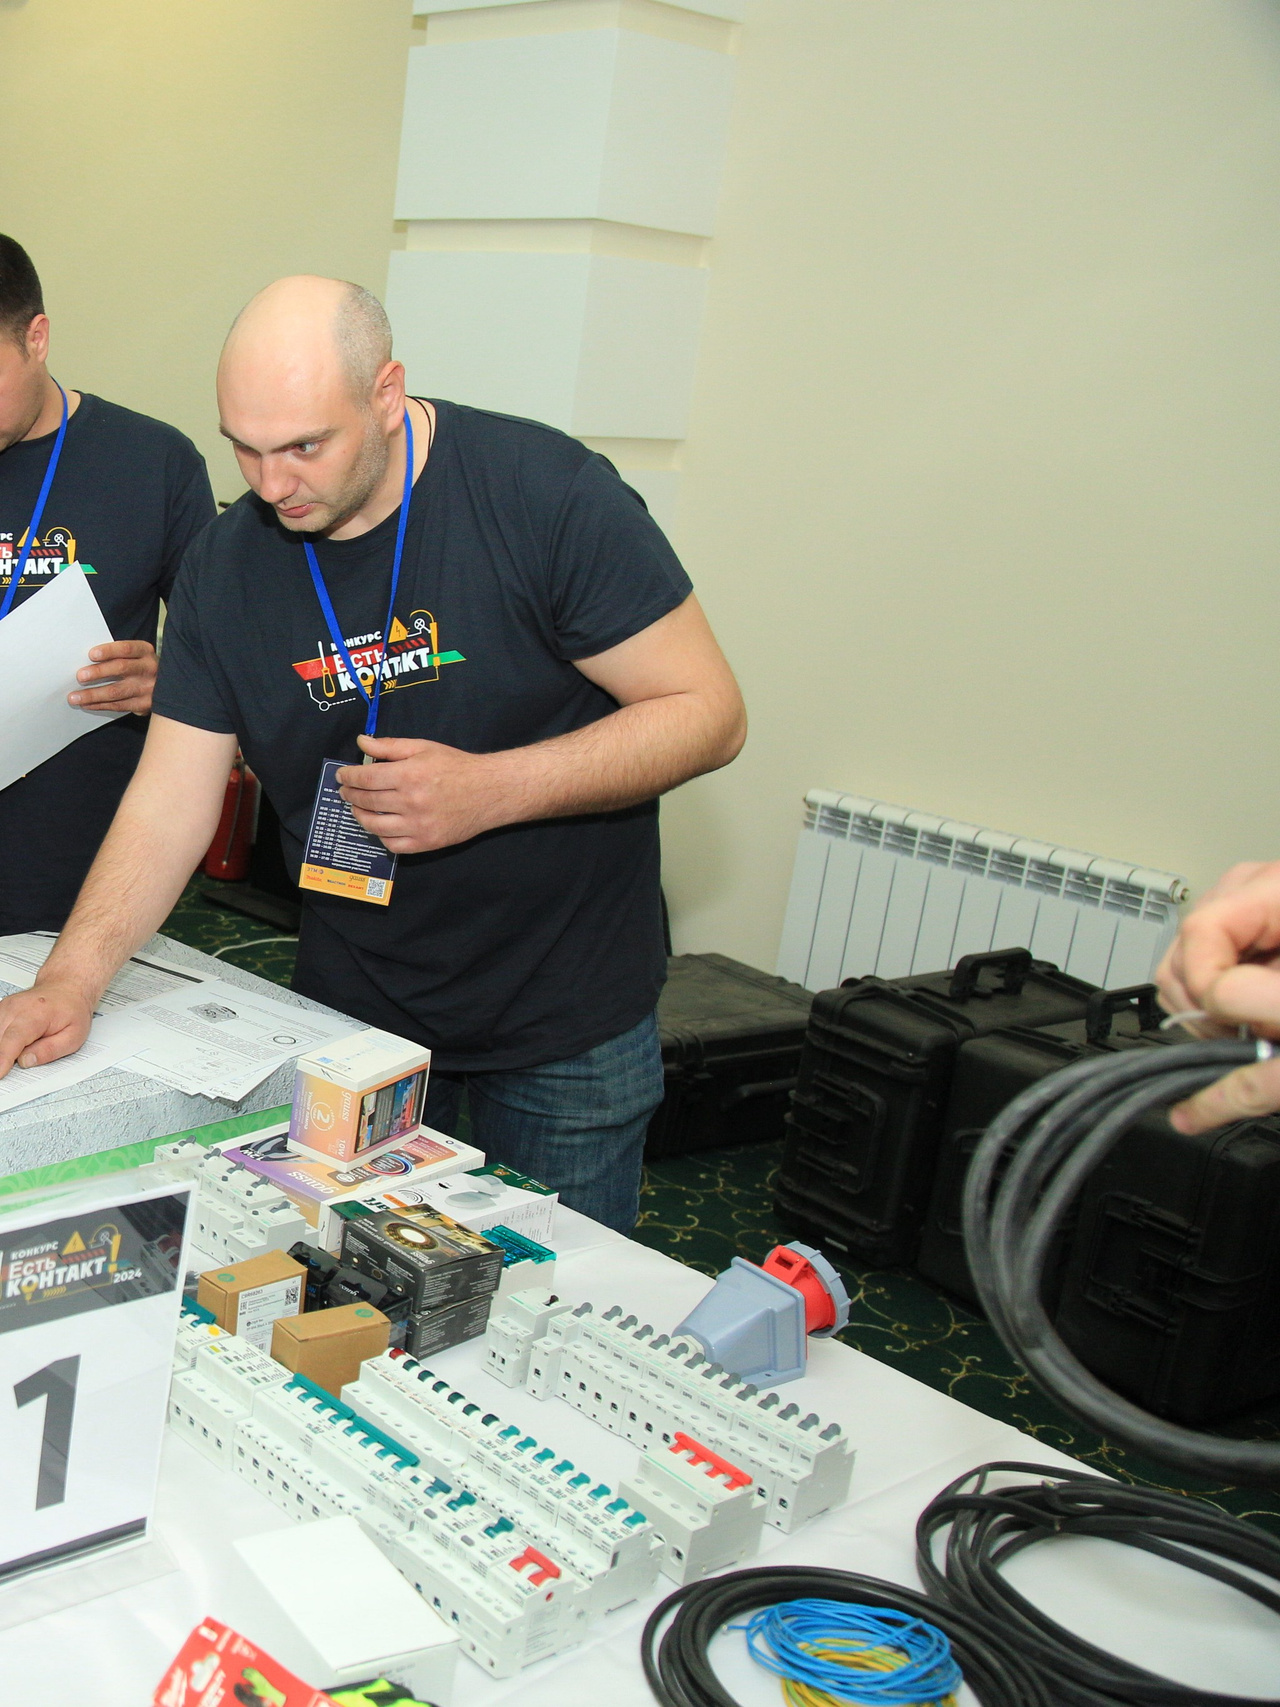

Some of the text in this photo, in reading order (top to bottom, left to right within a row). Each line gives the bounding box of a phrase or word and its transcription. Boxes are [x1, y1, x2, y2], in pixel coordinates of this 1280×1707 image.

[331, 630, 382, 652] КНКУРС
[317, 1109, 330, 1124] 2
[342, 1091, 352, 1122] gauss
[336, 1139, 346, 1158] 10W
[286, 1170, 335, 1195] gauss
[10, 1240, 59, 1261] КОНКУРС
[6, 1257, 107, 1299] КОНТАКТ
[8, 1257, 57, 1281] Есть
[113, 1268, 143, 1284] 2024
[12, 1354, 82, 1512] 1
